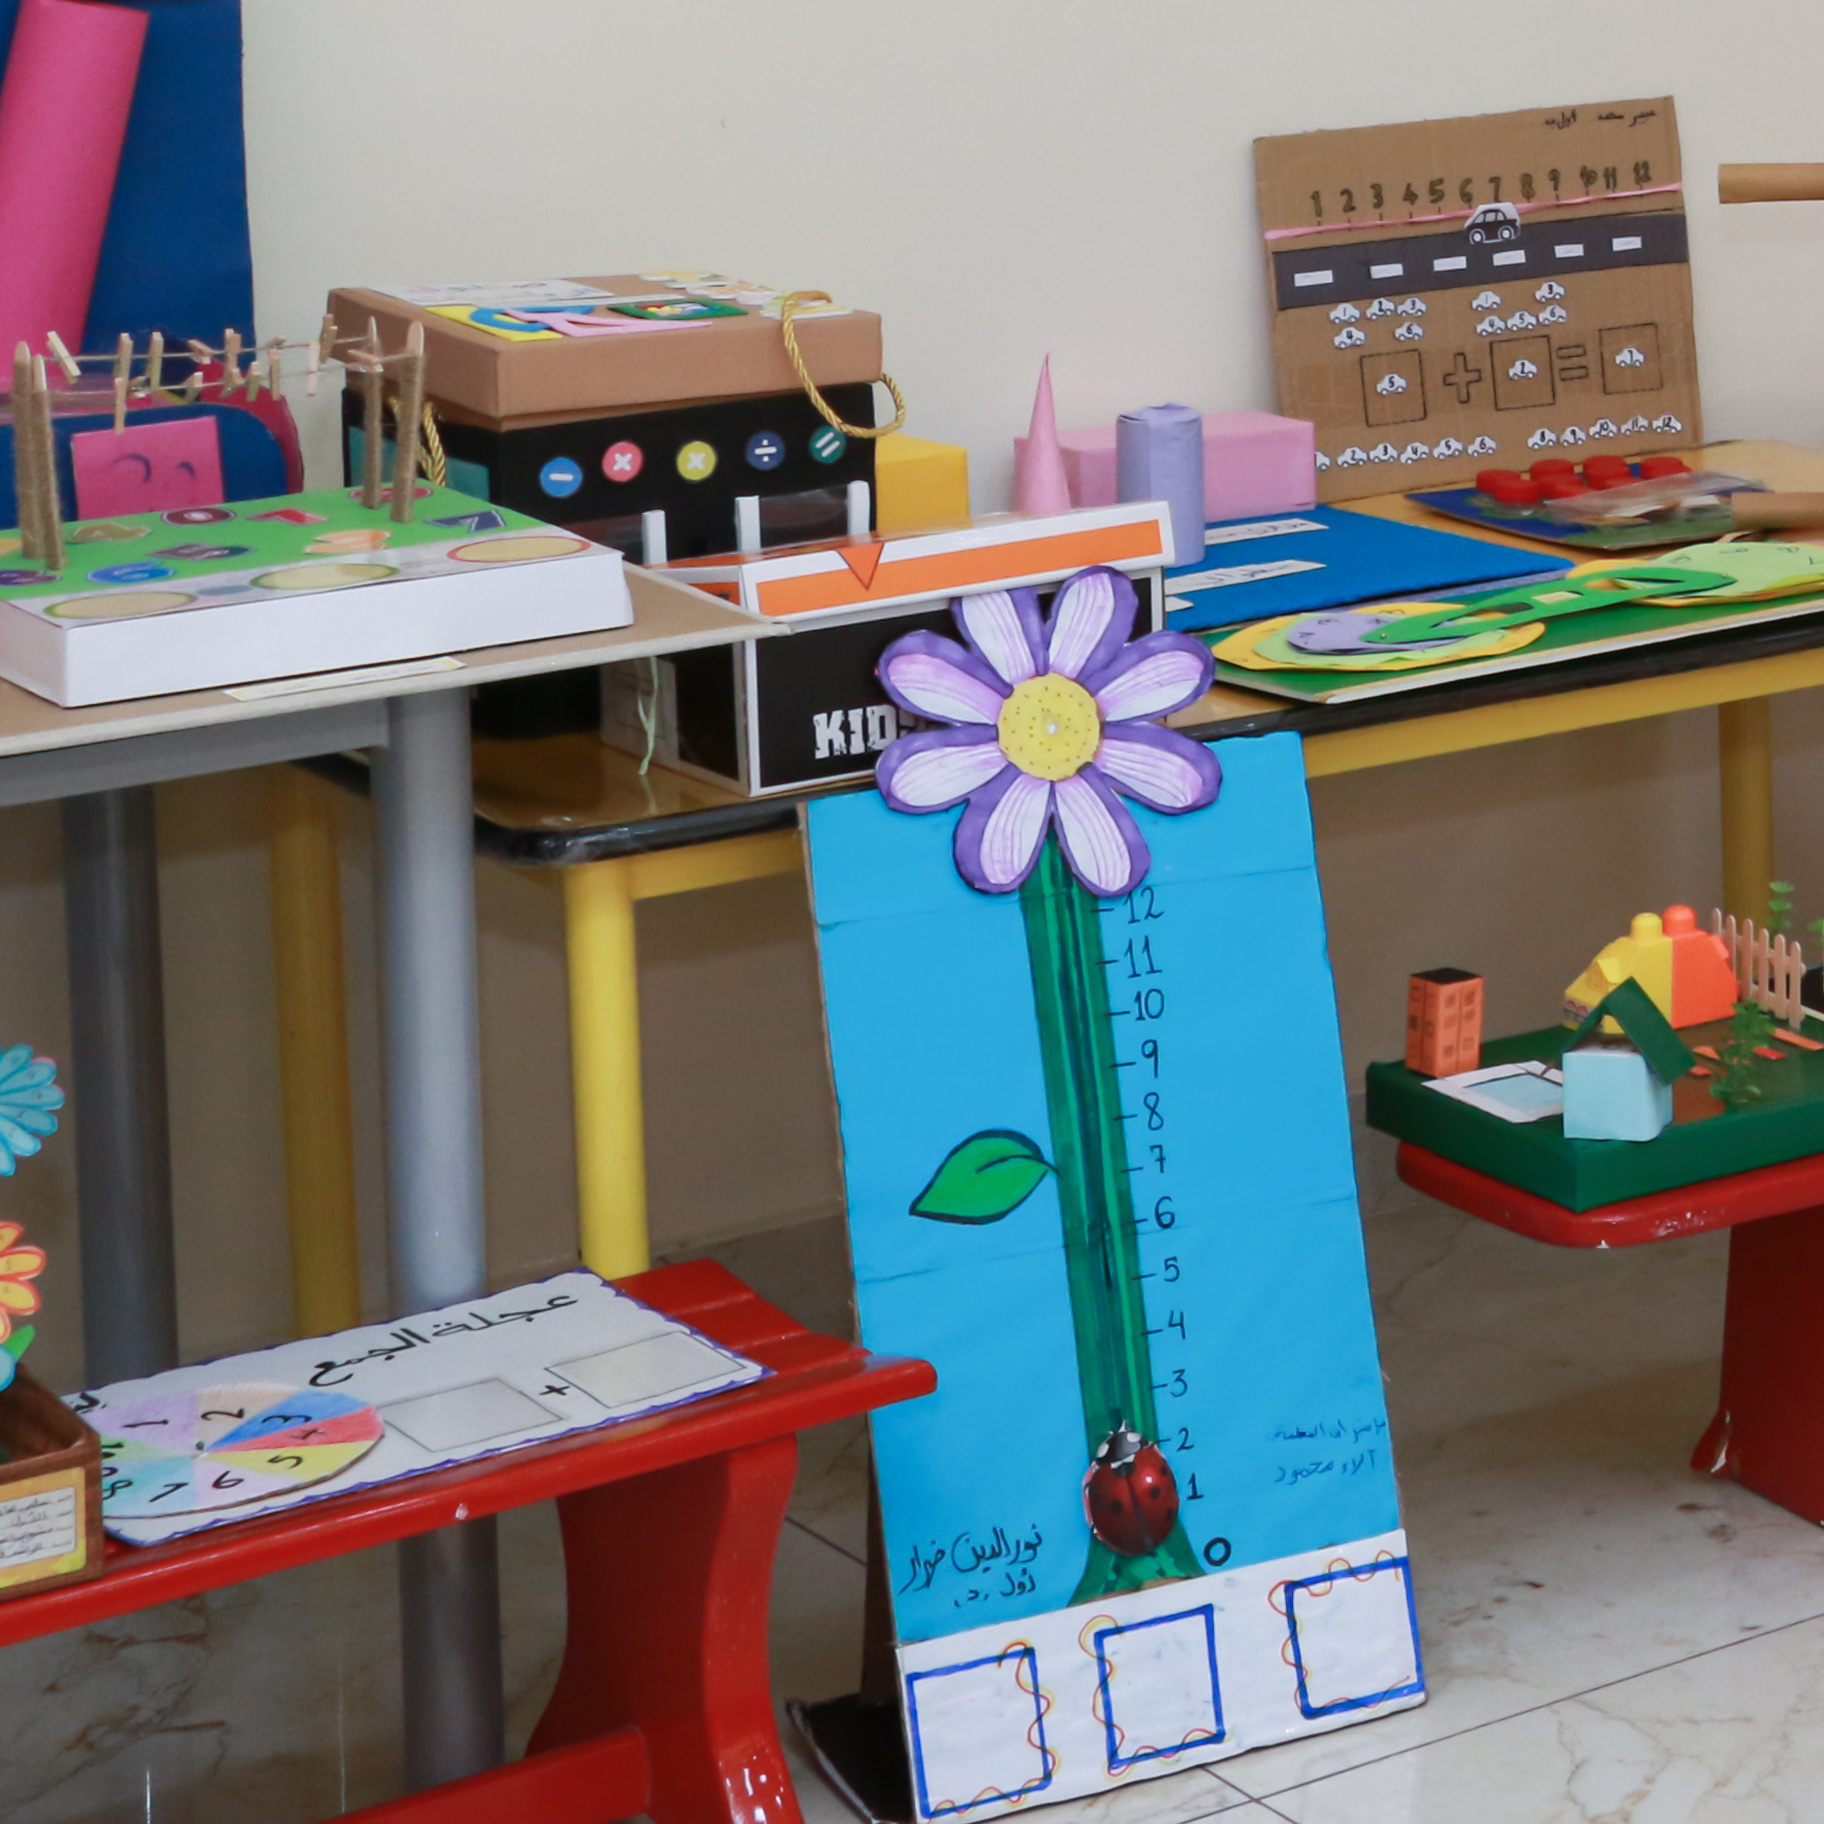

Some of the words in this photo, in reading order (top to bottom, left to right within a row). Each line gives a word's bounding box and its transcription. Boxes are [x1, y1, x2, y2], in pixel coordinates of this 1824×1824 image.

[1340, 188, 1356, 213] 2
[1371, 183, 1384, 209] 3
[1429, 178, 1445, 204] 5
[1124, 886, 1165, 923] 12
[1124, 943, 1158, 976] 11
[1133, 988, 1167, 1023] 10
[1141, 1040, 1160, 1078] 9
[1145, 1093, 1165, 1132] 8
[1150, 1144, 1168, 1175] 7
[1155, 1197, 1176, 1230] 6
[1161, 1259, 1181, 1285] 5
[1168, 1312, 1188, 1341] 4
[1171, 1369, 1190, 1400] 3
[1176, 1427, 1196, 1451] 2
[1188, 1474, 1204, 1501] 1
